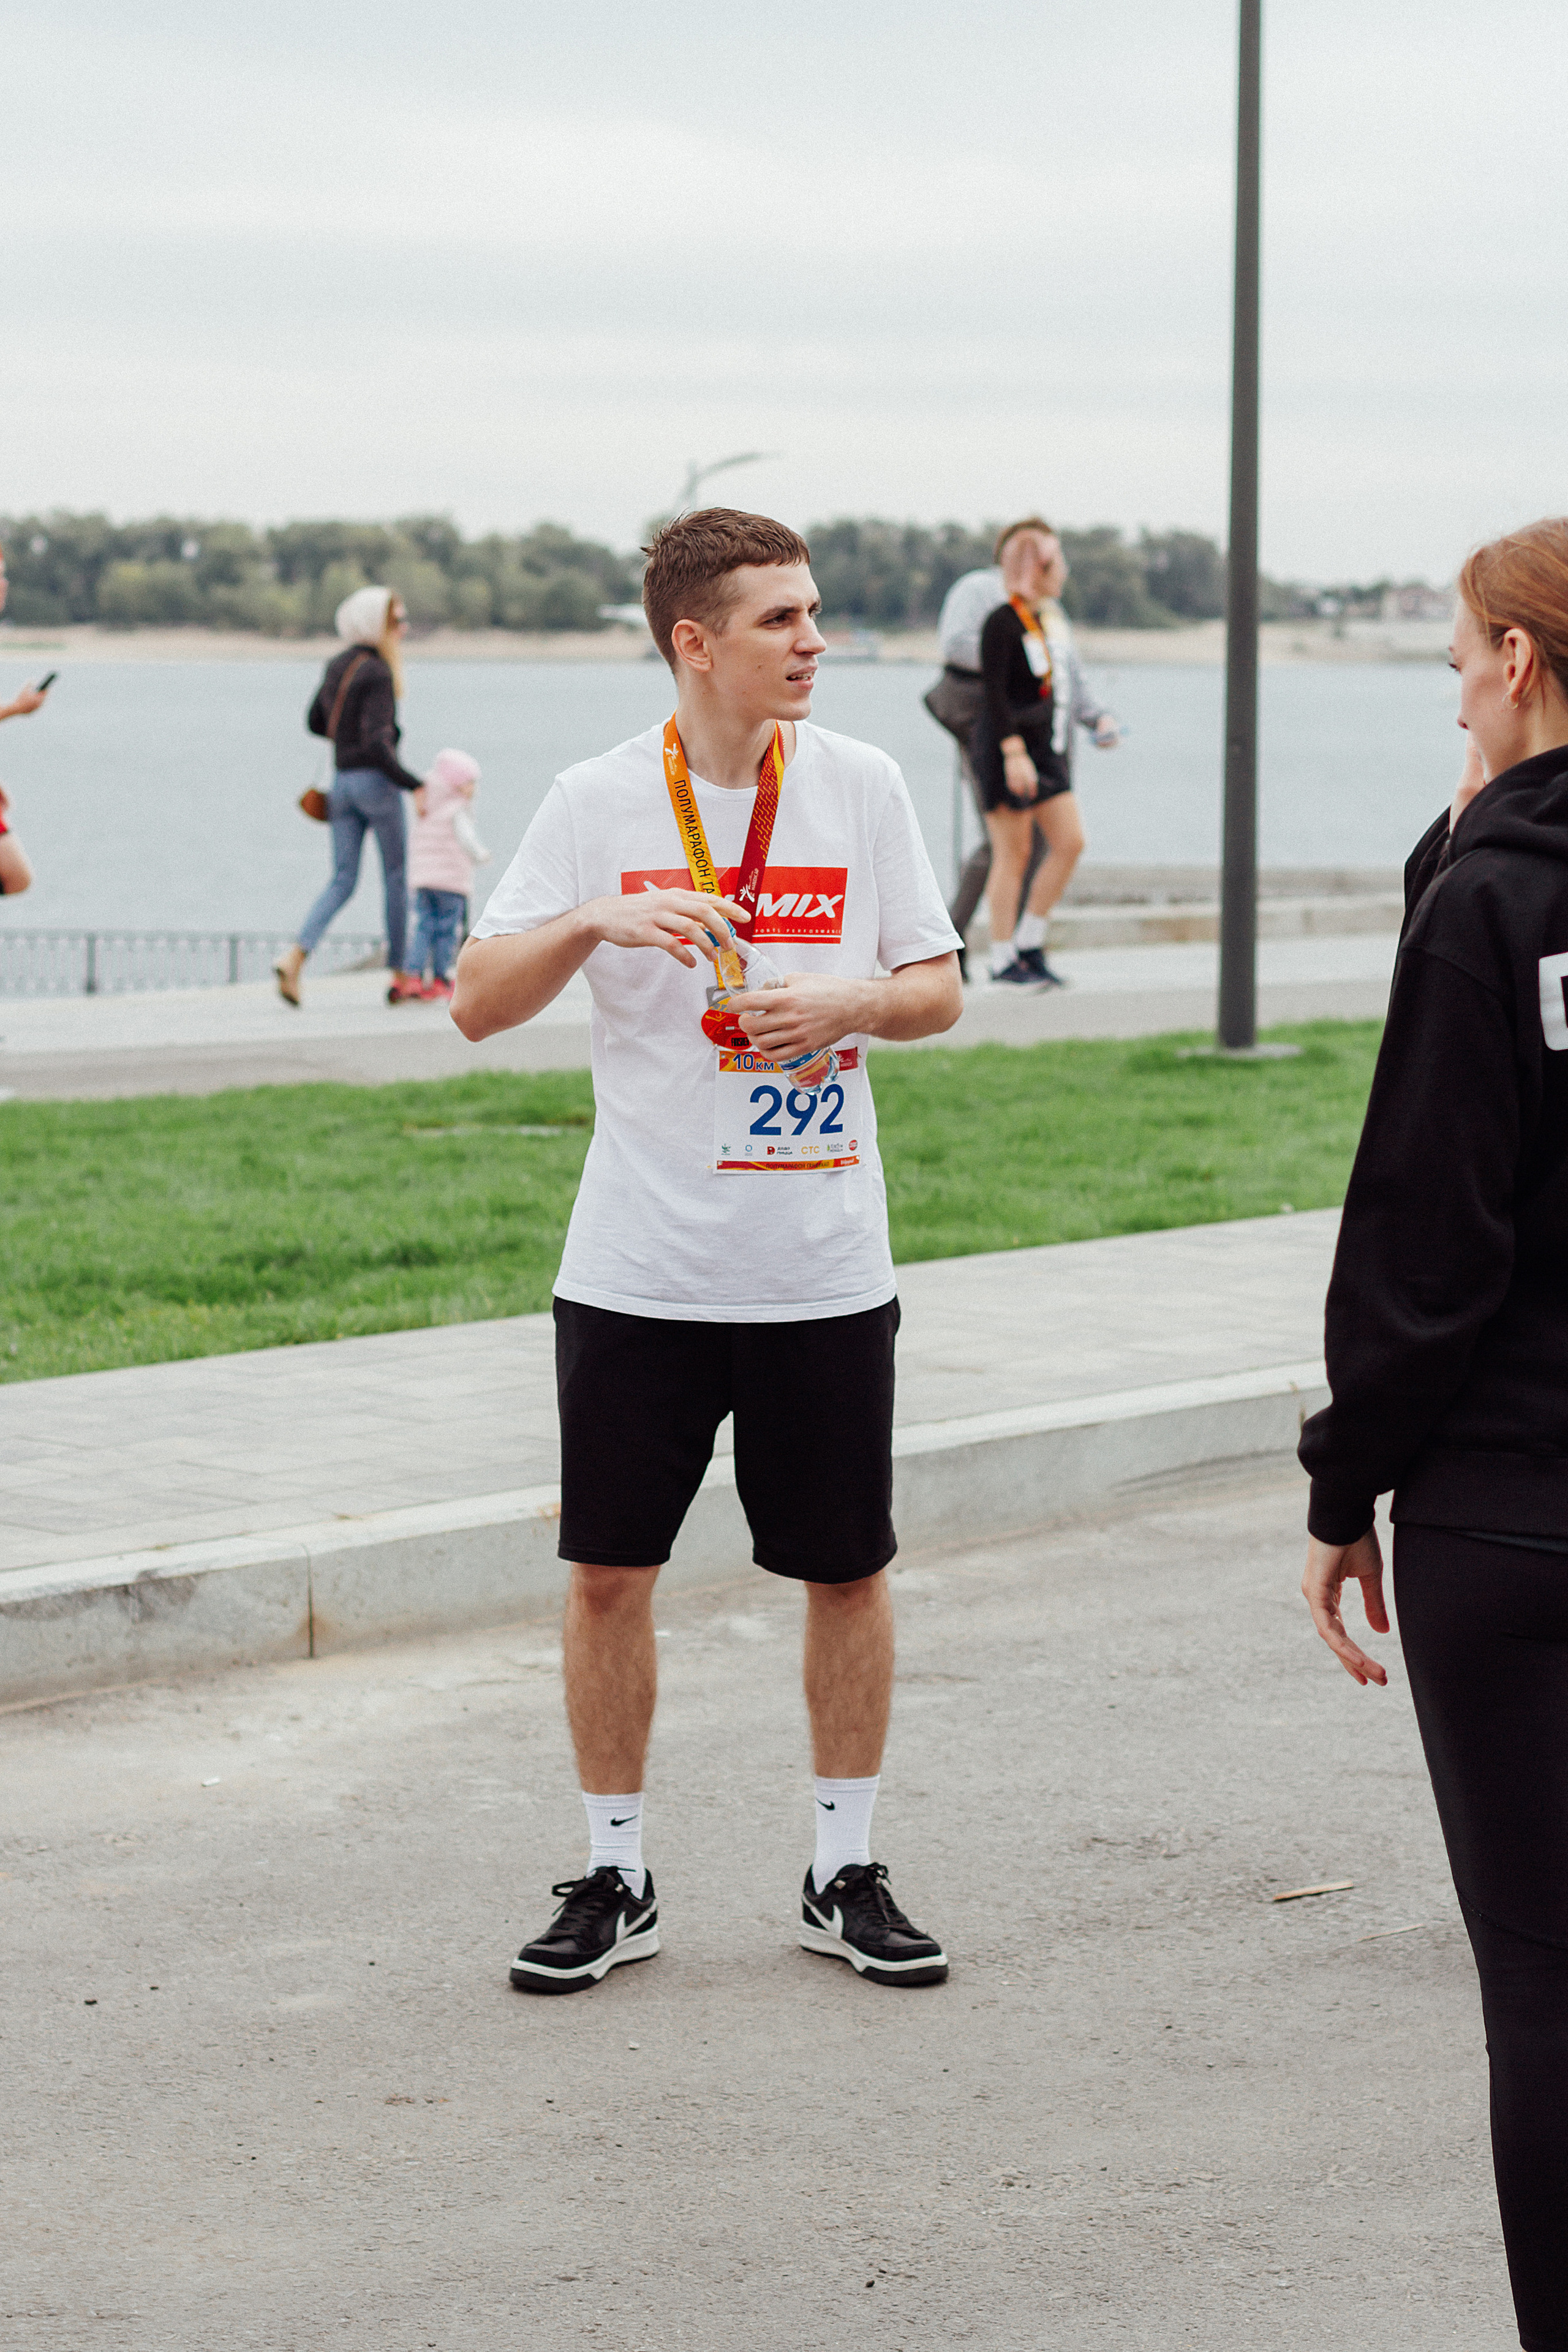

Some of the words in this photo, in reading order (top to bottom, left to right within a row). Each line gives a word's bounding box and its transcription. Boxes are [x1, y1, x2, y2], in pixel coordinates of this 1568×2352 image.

[674, 780, 711, 878] ПОЛУМАРАФОН
[701, 881, 715, 895] ГА
[749, 1084, 845, 1136] 292
[801, 1145, 820, 1155] СТС
